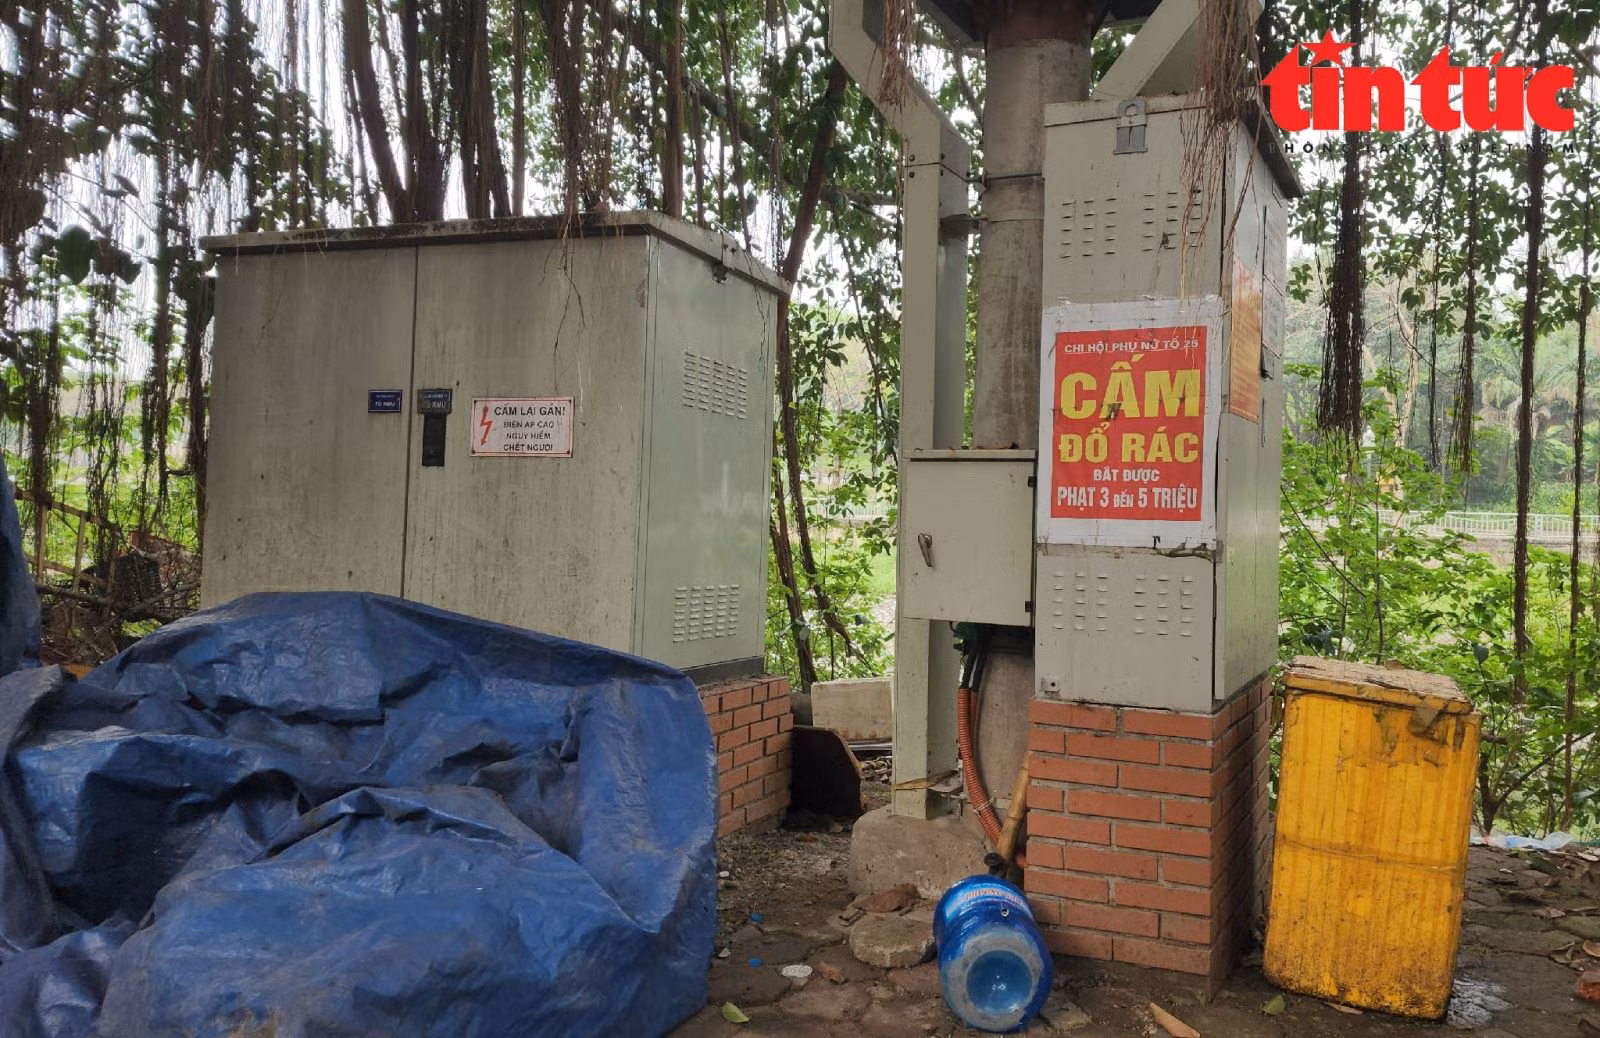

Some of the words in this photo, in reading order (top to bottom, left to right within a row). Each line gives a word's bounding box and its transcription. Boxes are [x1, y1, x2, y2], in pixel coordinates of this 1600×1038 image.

[1064, 343, 1084, 353] CHI
[1087, 341, 1108, 354] HỘI
[1112, 341, 1137, 353] PHỤ
[1060, 353, 1201, 420] CẤM
[494, 402, 517, 416] CẤM
[537, 421, 555, 429] CAO
[1058, 421, 1110, 463] ĐỔ
[1121, 426, 1199, 463] RÁC
[1093, 465, 1119, 482] BẮT
[1122, 468, 1160, 484] ĐƯỢC
[1057, 486, 1096, 511] PHẠT
[1100, 486, 1110, 507] 3
[1113, 489, 1134, 508] ĐẾN
[1138, 487, 1148, 508] 5
[1151, 483, 1198, 513] TRIỆU
